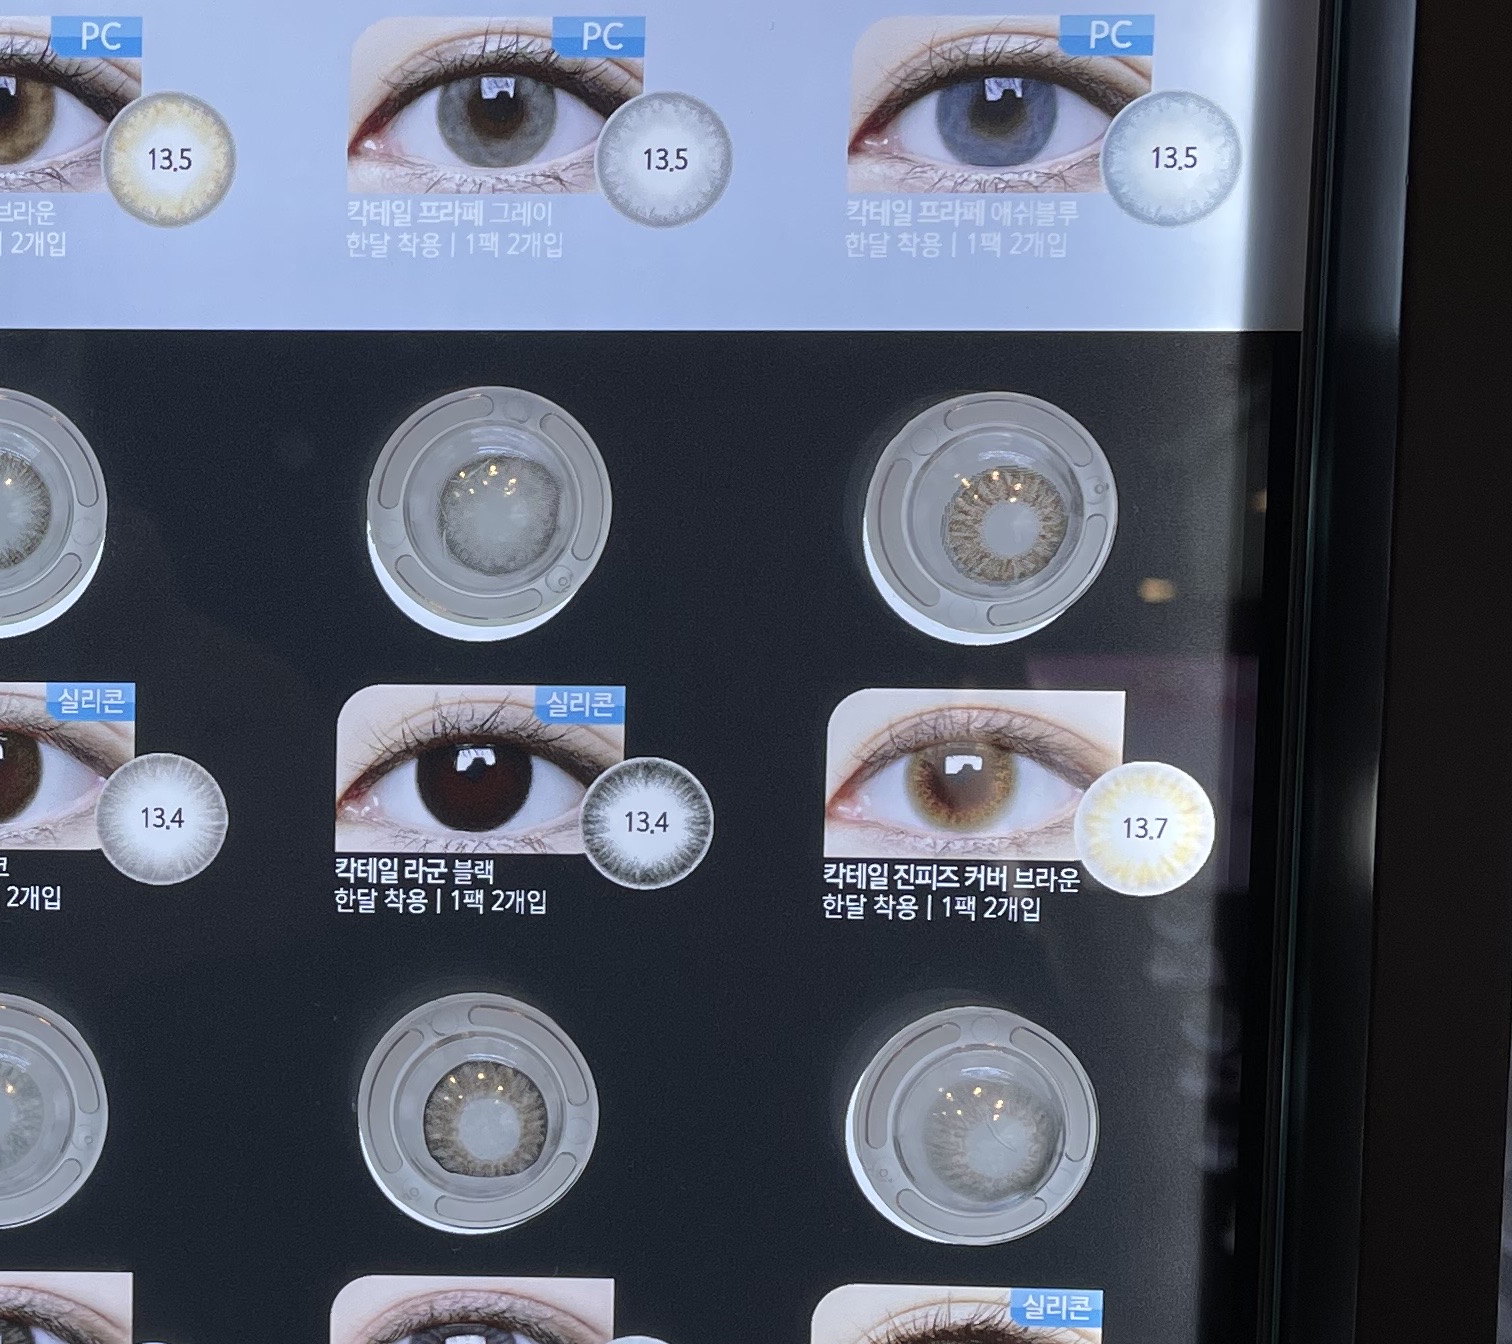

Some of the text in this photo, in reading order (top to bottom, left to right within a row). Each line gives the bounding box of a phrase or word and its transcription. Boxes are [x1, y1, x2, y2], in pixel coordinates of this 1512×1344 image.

[81, 22, 121, 50] PC
[582, 22, 623, 50] PC
[1090, 20, 1132, 50] PC
[148, 148, 192, 172] 13.5
[644, 148, 688, 172] 13.5
[1151, 146, 1198, 171] 13.5
[348, 199, 552, 227] 칵테일 프라페 그레이
[847, 199, 1079, 226] 칵테일 프라페 애쉬블루
[347, 232, 564, 257] 한달 착용 1팩 2개입
[58, 689, 125, 714] 실리콘
[547, 692, 615, 718] 실리콘
[141, 807, 184, 830] 13.4
[625, 812, 669, 834] 13.4
[1123, 818, 1168, 840] 13.7
[335, 858, 494, 885] 칵테일 라군 블랙
[823, 863, 1080, 893] 칵테일 진피즈 커버 브라운
[335, 888, 547, 915] 한달 착용 1팩 2개입
[1023, 1295, 1091, 1321] 실리콘
